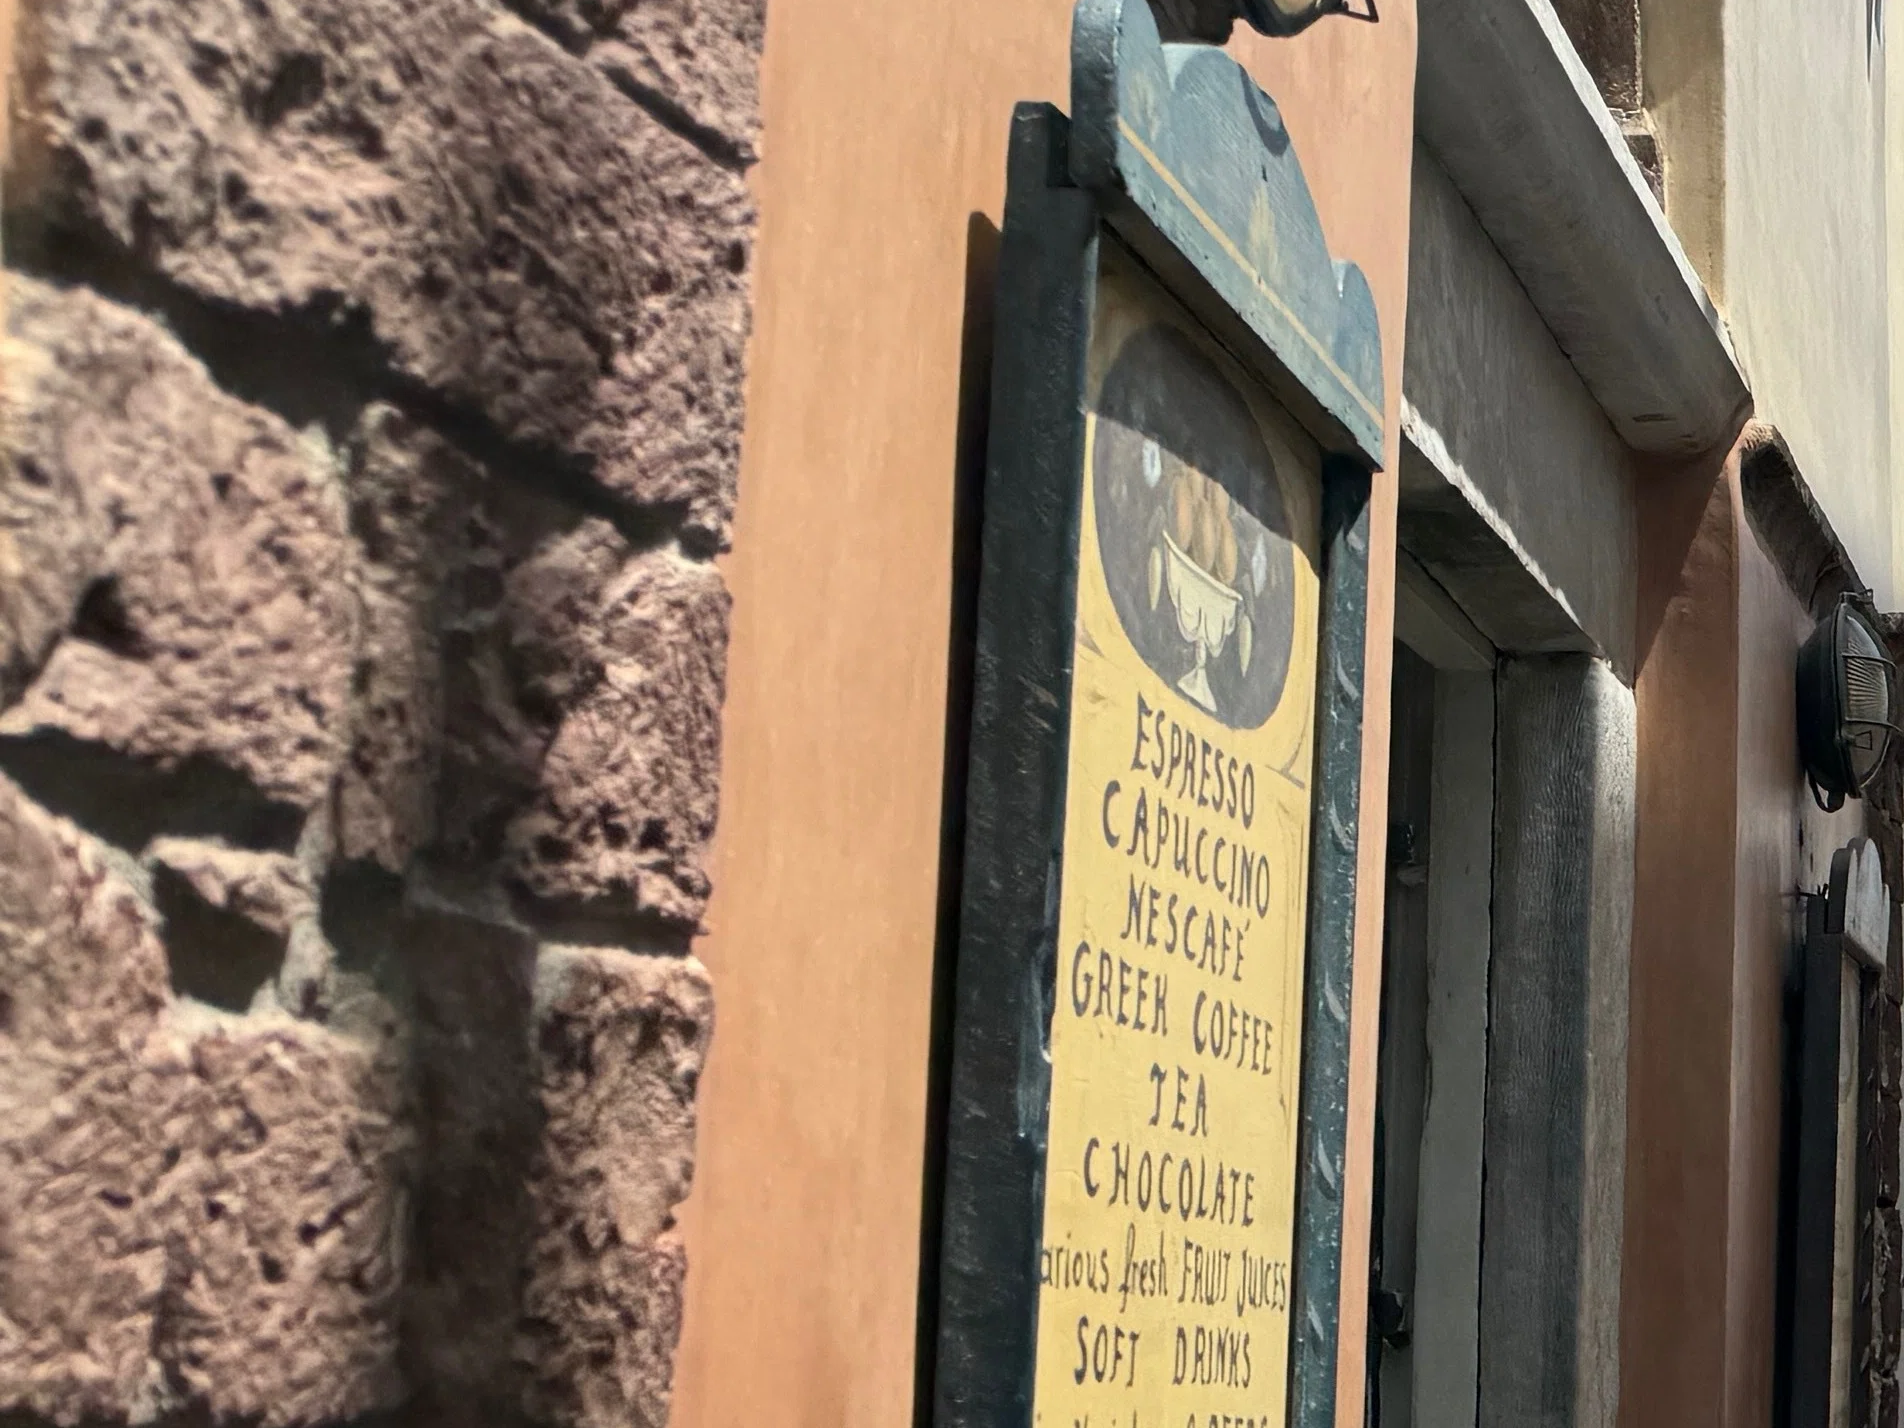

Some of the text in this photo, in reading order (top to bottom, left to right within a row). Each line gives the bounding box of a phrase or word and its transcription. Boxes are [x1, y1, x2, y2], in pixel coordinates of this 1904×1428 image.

[1131, 692, 1256, 830] ESPRESSO
[1102, 779, 1271, 920] CAPUCCINO
[1120, 875, 1252, 982] NESCAFÉ
[1072, 941, 1273, 1075] GREEK COFFEE
[1149, 1063, 1209, 1137] TEA
[1083, 1137, 1255, 1227] CHOCOLATE
[1040, 1222, 1287, 1317] arious fresh FRUIT JUICES
[1074, 1315, 1251, 1390] SOFT DRINKS
